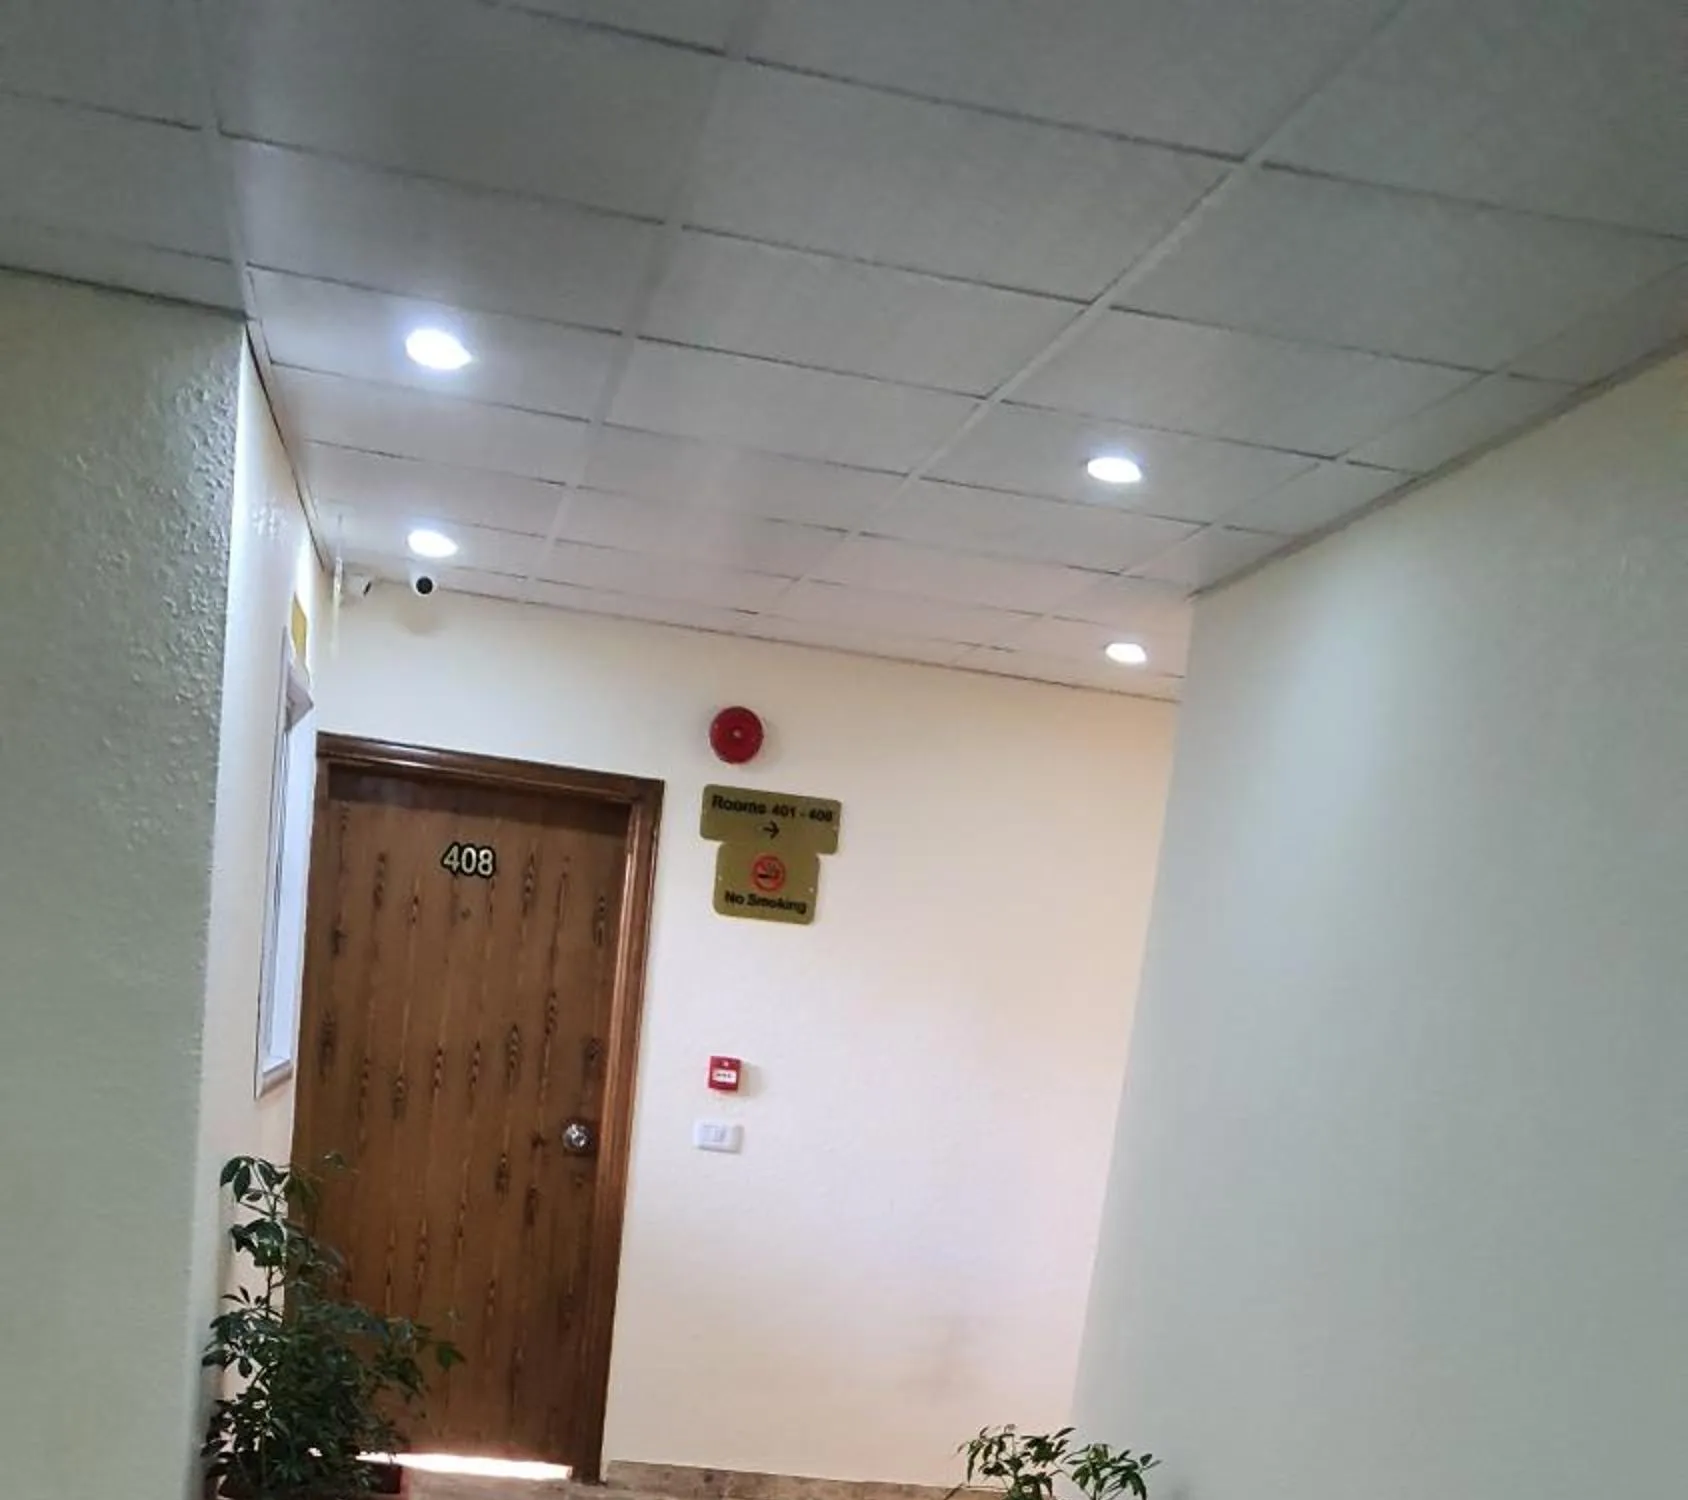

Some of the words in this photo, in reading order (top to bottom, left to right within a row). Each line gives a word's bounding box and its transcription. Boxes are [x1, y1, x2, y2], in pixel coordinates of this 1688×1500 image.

[711, 794, 767, 815] Rooms
[771, 803, 797, 818] 401
[441, 843, 495, 878] 408
[725, 890, 745, 905] No
[746, 893, 807, 915] Smoking
